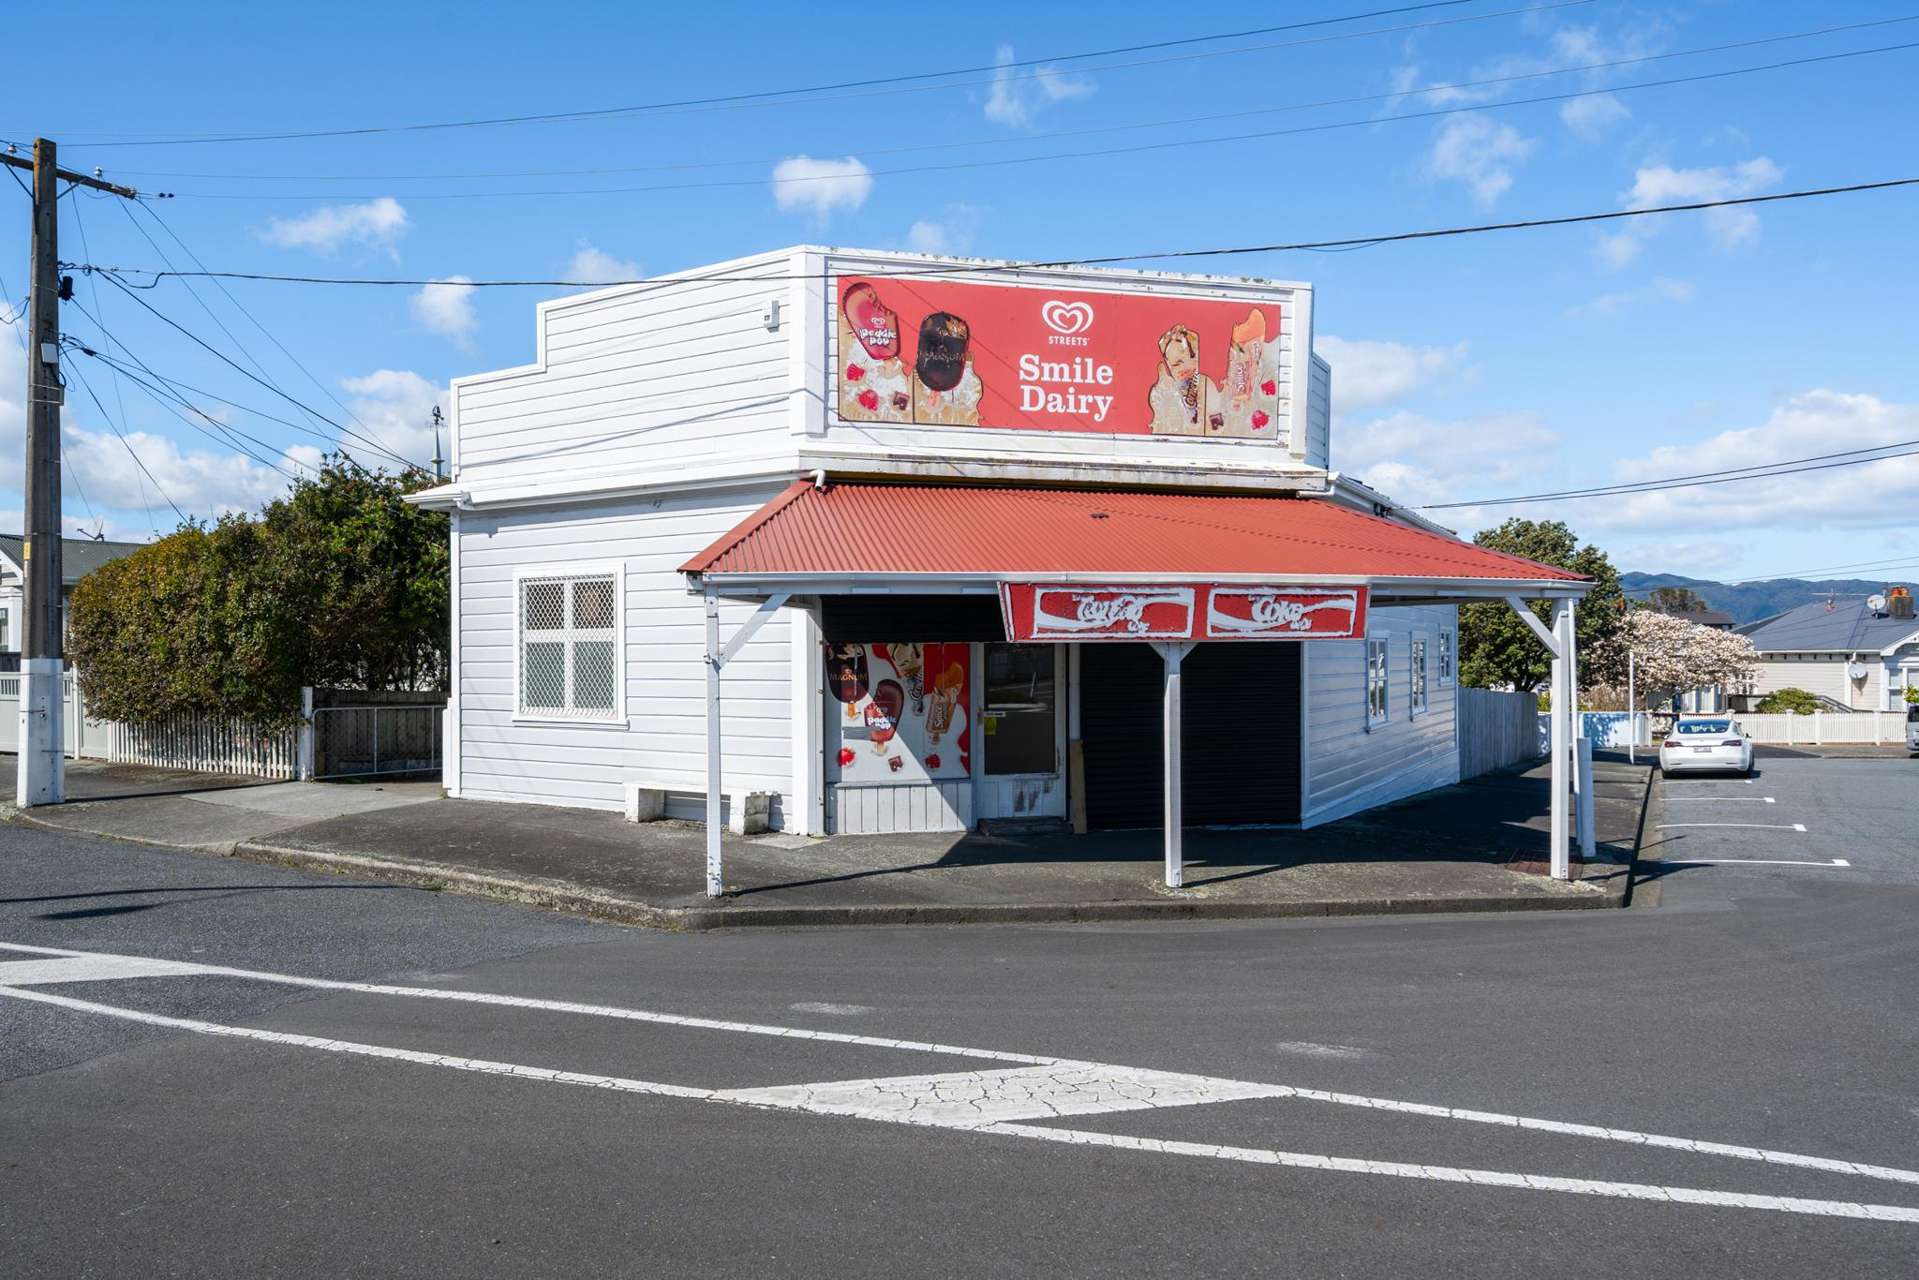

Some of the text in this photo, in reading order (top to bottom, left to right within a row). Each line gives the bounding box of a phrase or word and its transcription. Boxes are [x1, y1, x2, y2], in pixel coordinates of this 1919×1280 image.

[1048, 335, 1089, 346] STREETS
[1019, 353, 1113, 385] Smile
[1019, 384, 1114, 422] Dairy
[829, 673, 868, 681] MAGNUM
